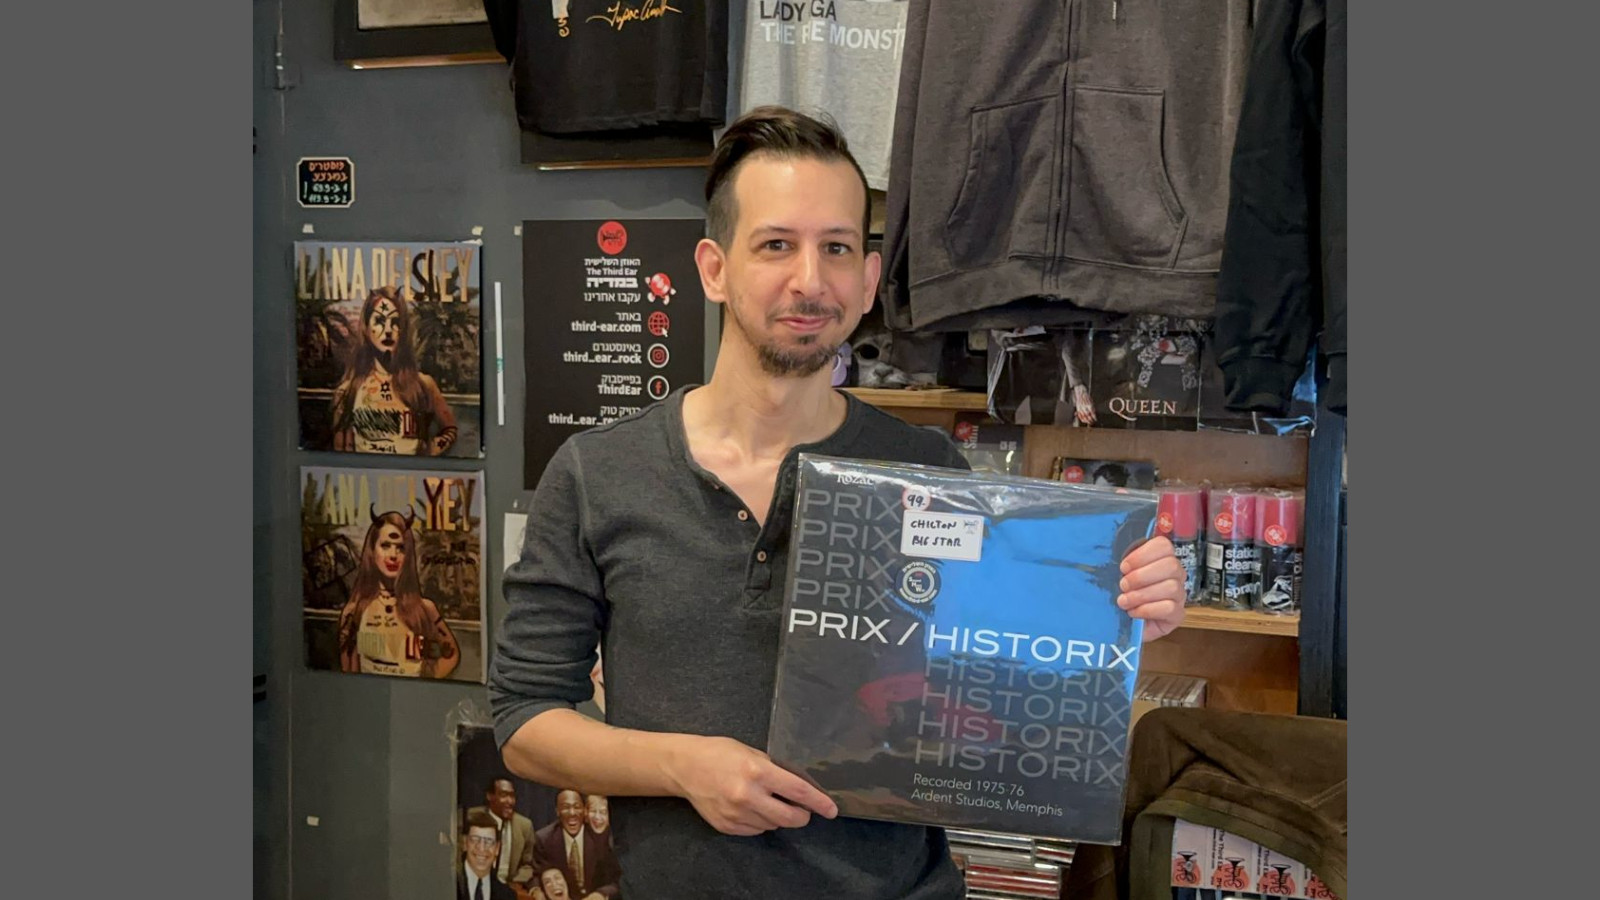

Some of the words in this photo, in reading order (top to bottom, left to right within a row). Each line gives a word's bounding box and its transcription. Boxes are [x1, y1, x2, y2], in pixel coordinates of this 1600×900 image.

[584, 257, 619, 267] השלישית
[620, 258, 641, 267] האוזן
[299, 247, 368, 300] LANA
[603, 267, 624, 276] Third
[625, 268, 638, 276] Ear
[586, 277, 639, 288] במדיה
[584, 292, 615, 302] אחרינו
[617, 292, 641, 304] עקבו
[616, 312, 642, 322] באתר
[571, 320, 642, 332] third-ear.com
[592, 342, 642, 352] באינסטגרם
[563, 352, 642, 364] third_ear_rock
[601, 374, 642, 384] בפייסבוק
[597, 384, 642, 395] ThirdEar
[1109, 397, 1177, 421] QUEEN
[548, 413, 619, 425] third_ear_re
[802, 488, 902, 523] PRIX
[799, 518, 900, 553] PRIX
[795, 548, 897, 583] PRIX
[792, 579, 892, 612] PRIX
[788, 608, 891, 644] PRIX
[928, 623, 1138, 671] HISTORIX
[925, 657, 1130, 699] HISTORIX
[921, 682, 1130, 729] HISTORIX
[918, 710, 1126, 758] HISTORIX
[915, 739, 1123, 787] HISTORIX
[913, 773, 972, 790] Recorded
[910, 788, 953, 804] Ardent
[956, 793, 1003, 811] Studios,
[1006, 799, 1063, 818] Memphis
